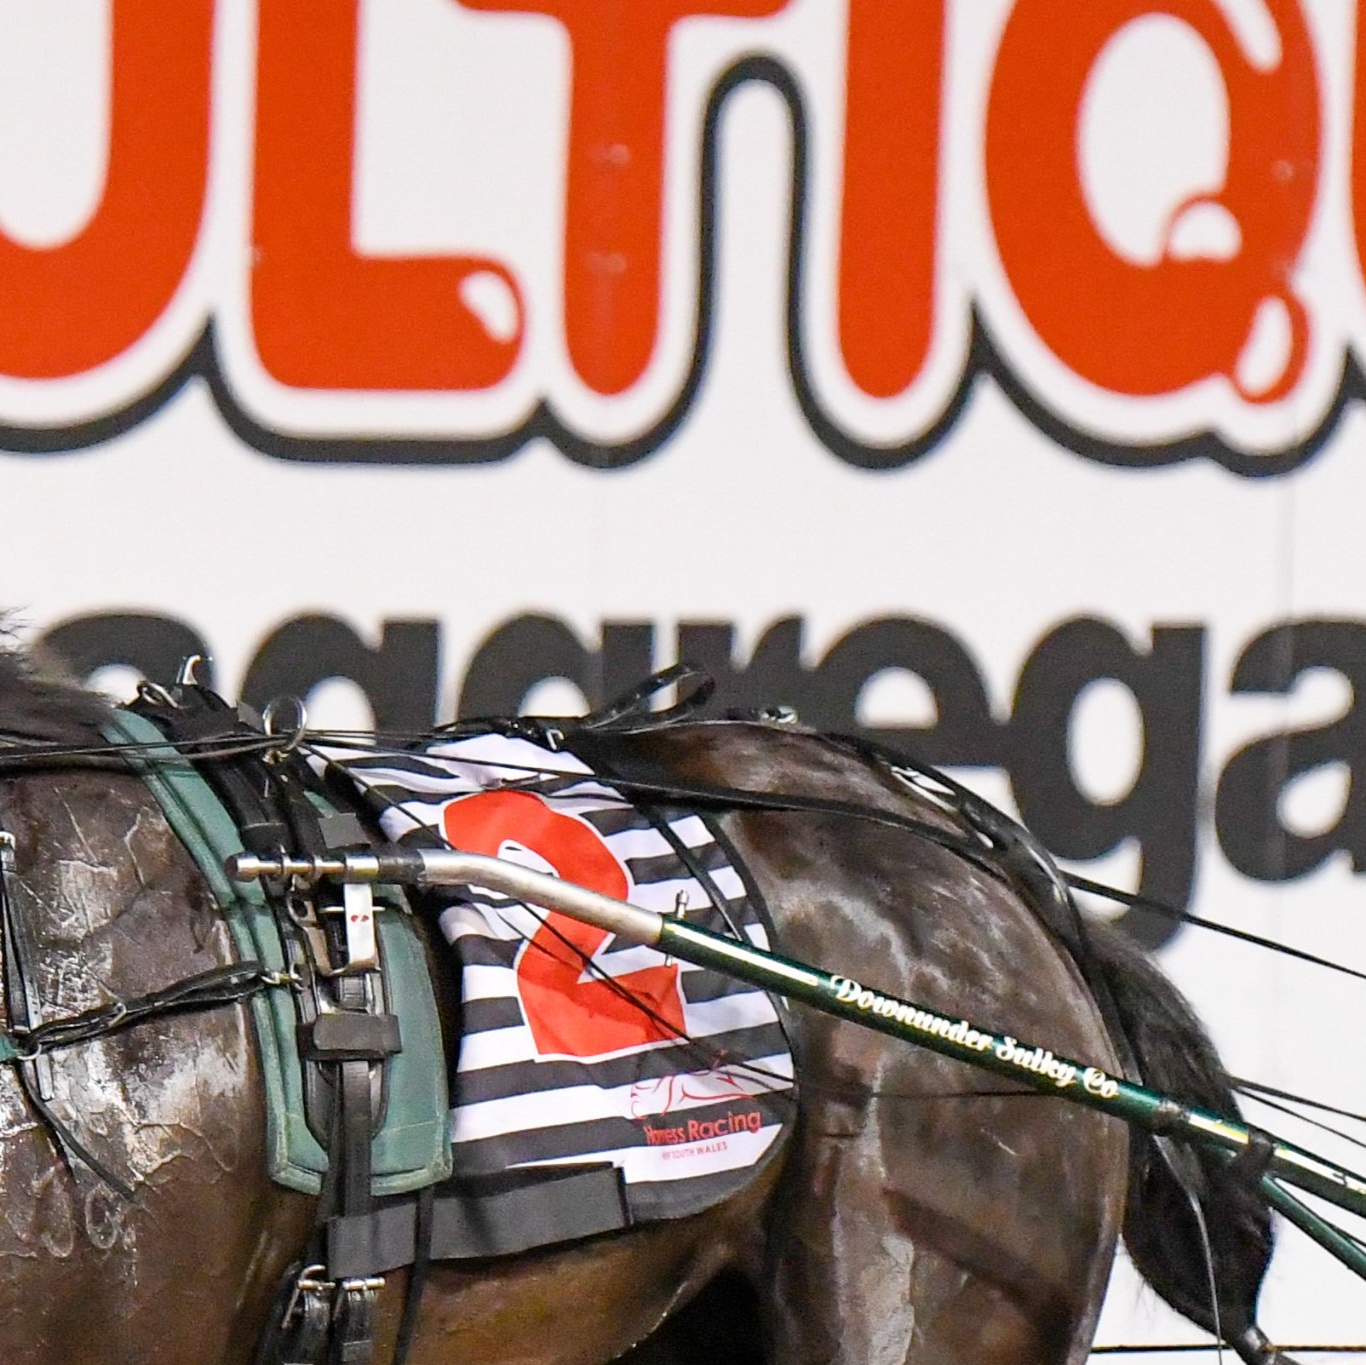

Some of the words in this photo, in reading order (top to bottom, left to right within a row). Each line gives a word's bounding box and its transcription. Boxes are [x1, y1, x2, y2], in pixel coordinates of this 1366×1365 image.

[443, 788, 688, 1057] 2
[829, 974, 993, 1051] Downunder
[995, 1036, 1077, 1087] Sulky
[1083, 1066, 1120, 1098] Co
[687, 1110, 762, 1142] Racing
